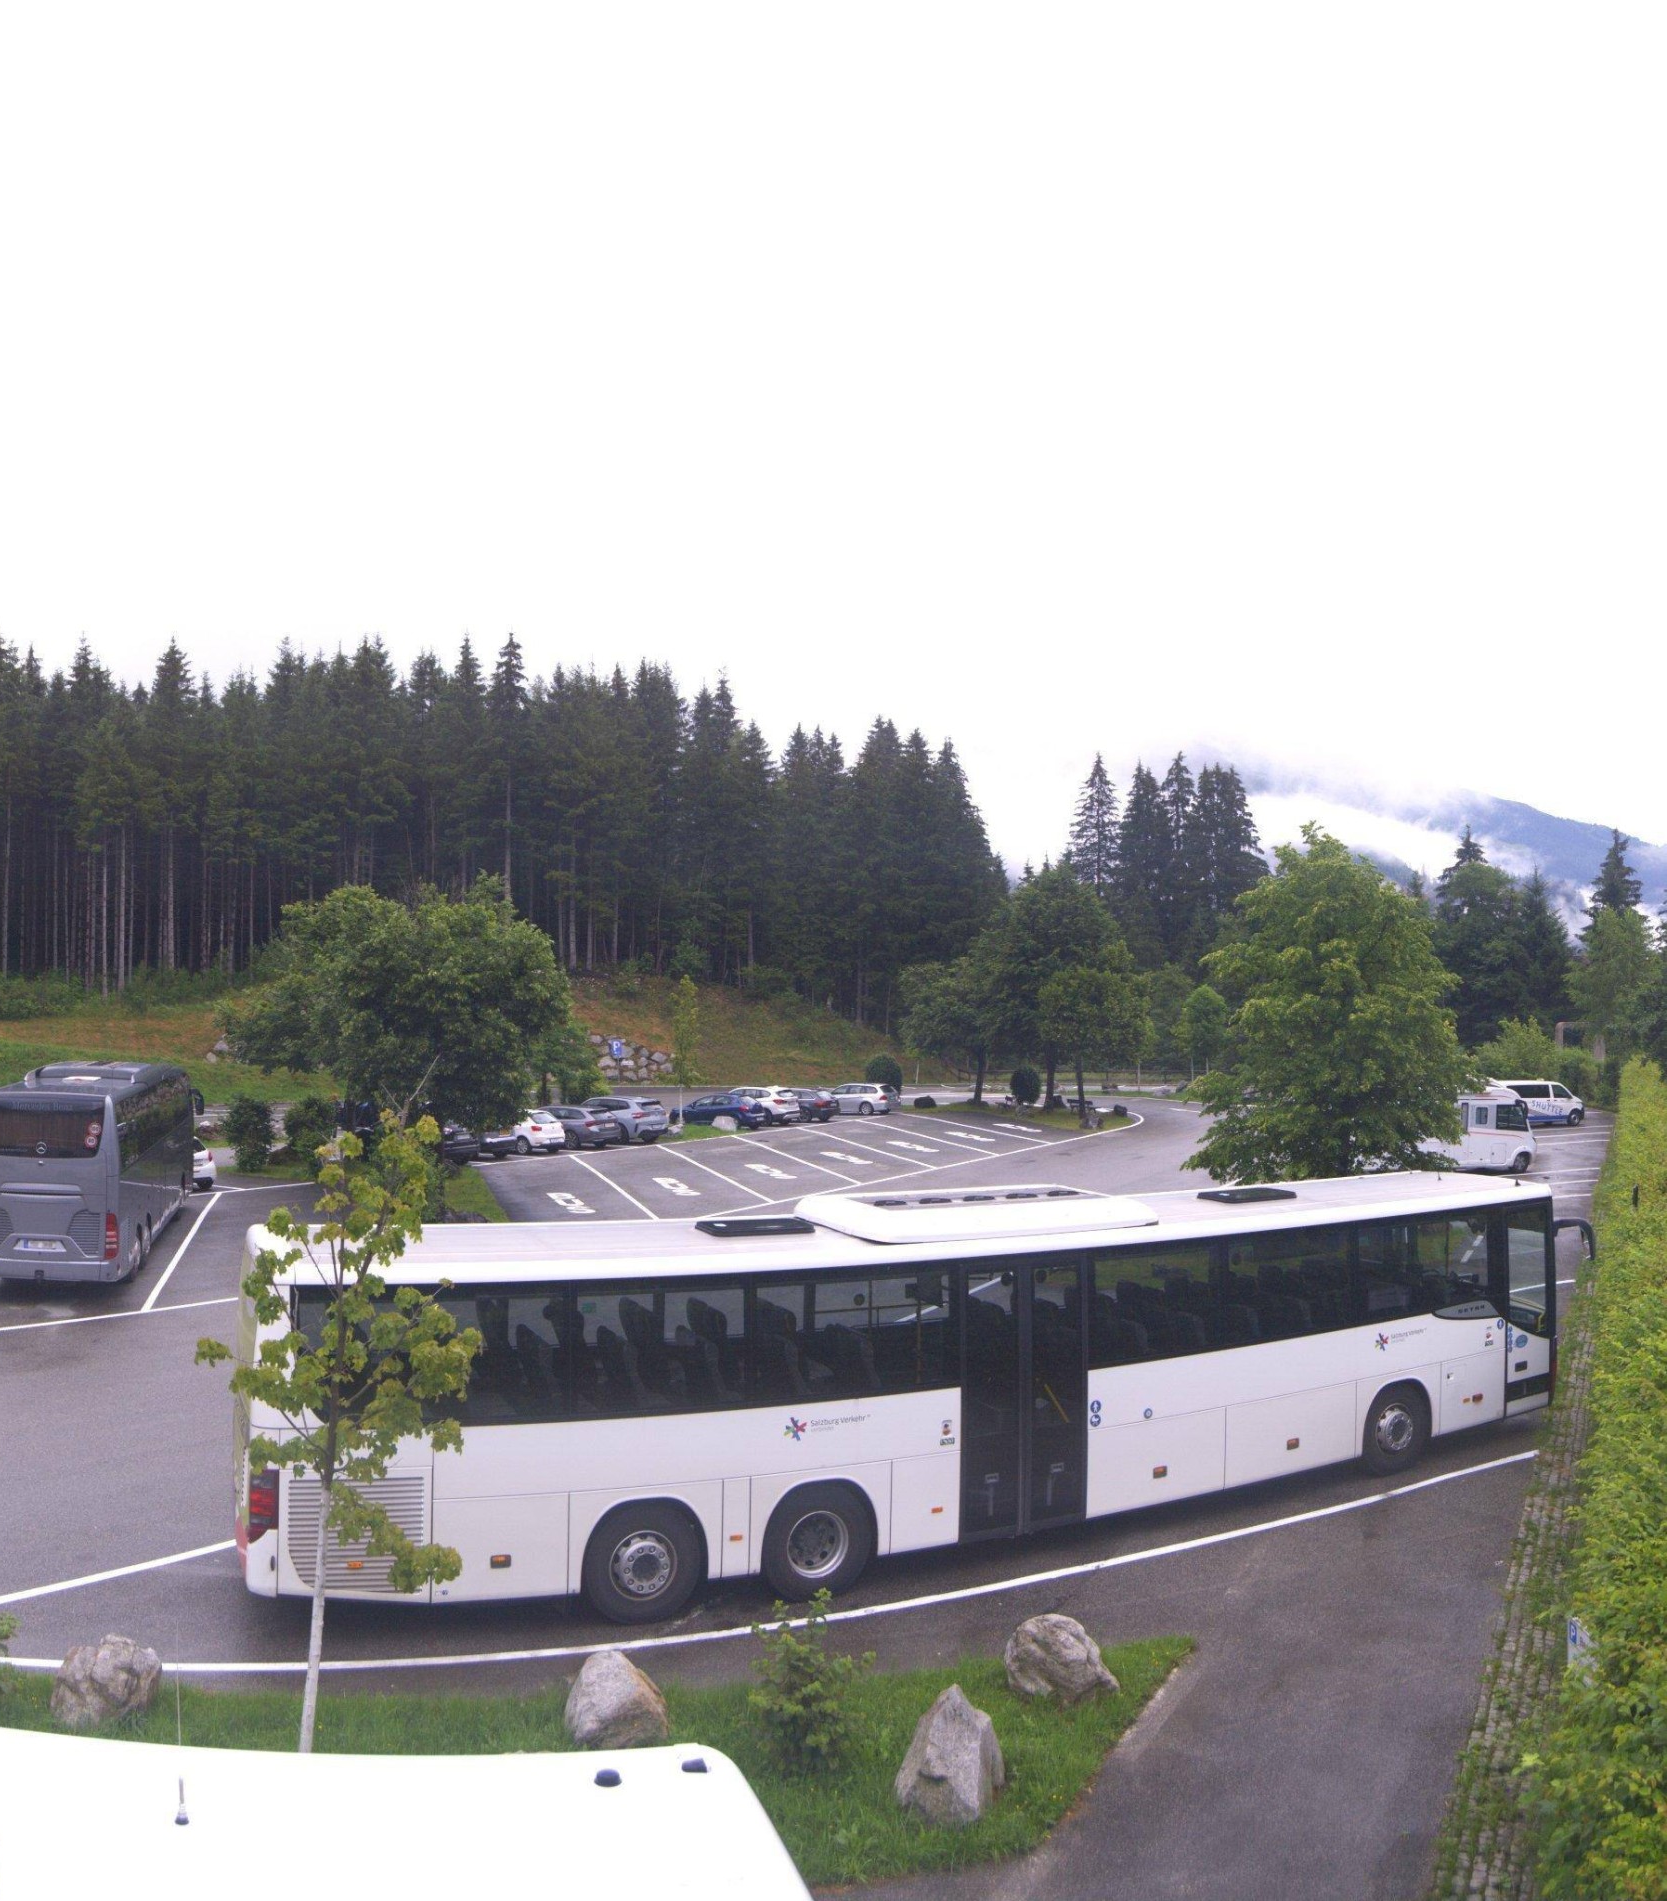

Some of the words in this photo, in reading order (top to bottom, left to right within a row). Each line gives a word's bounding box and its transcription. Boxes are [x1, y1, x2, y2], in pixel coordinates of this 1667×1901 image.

[1531, 1100, 1564, 1116] SHUTTLE
[810, 1416, 839, 1428] Salzburg
[840, 1414, 866, 1425] Verkehr
